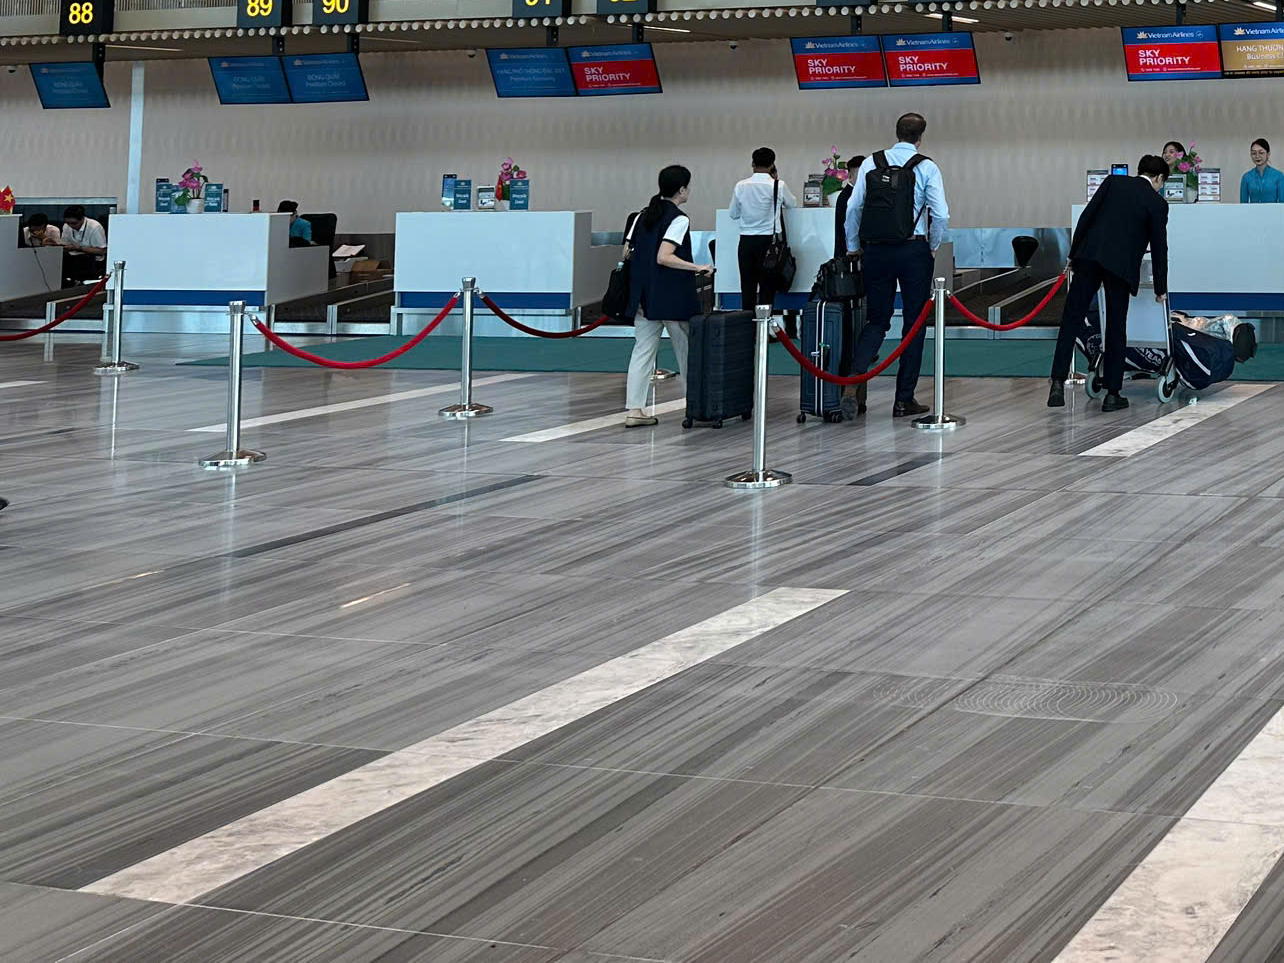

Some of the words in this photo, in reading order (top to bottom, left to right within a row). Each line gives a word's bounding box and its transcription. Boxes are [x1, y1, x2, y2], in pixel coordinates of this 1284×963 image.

[68, 2, 94, 25] 88
[1138, 49, 1160, 57] SKY
[808, 59, 828, 67] SKY
[1140, 57, 1190, 65] PRIORITY
[584, 67, 603, 75] SKY
[809, 66, 856, 74] PRIORITY
[900, 63, 948, 71] PRIORITY
[586, 73, 630, 82] PRIORITY
